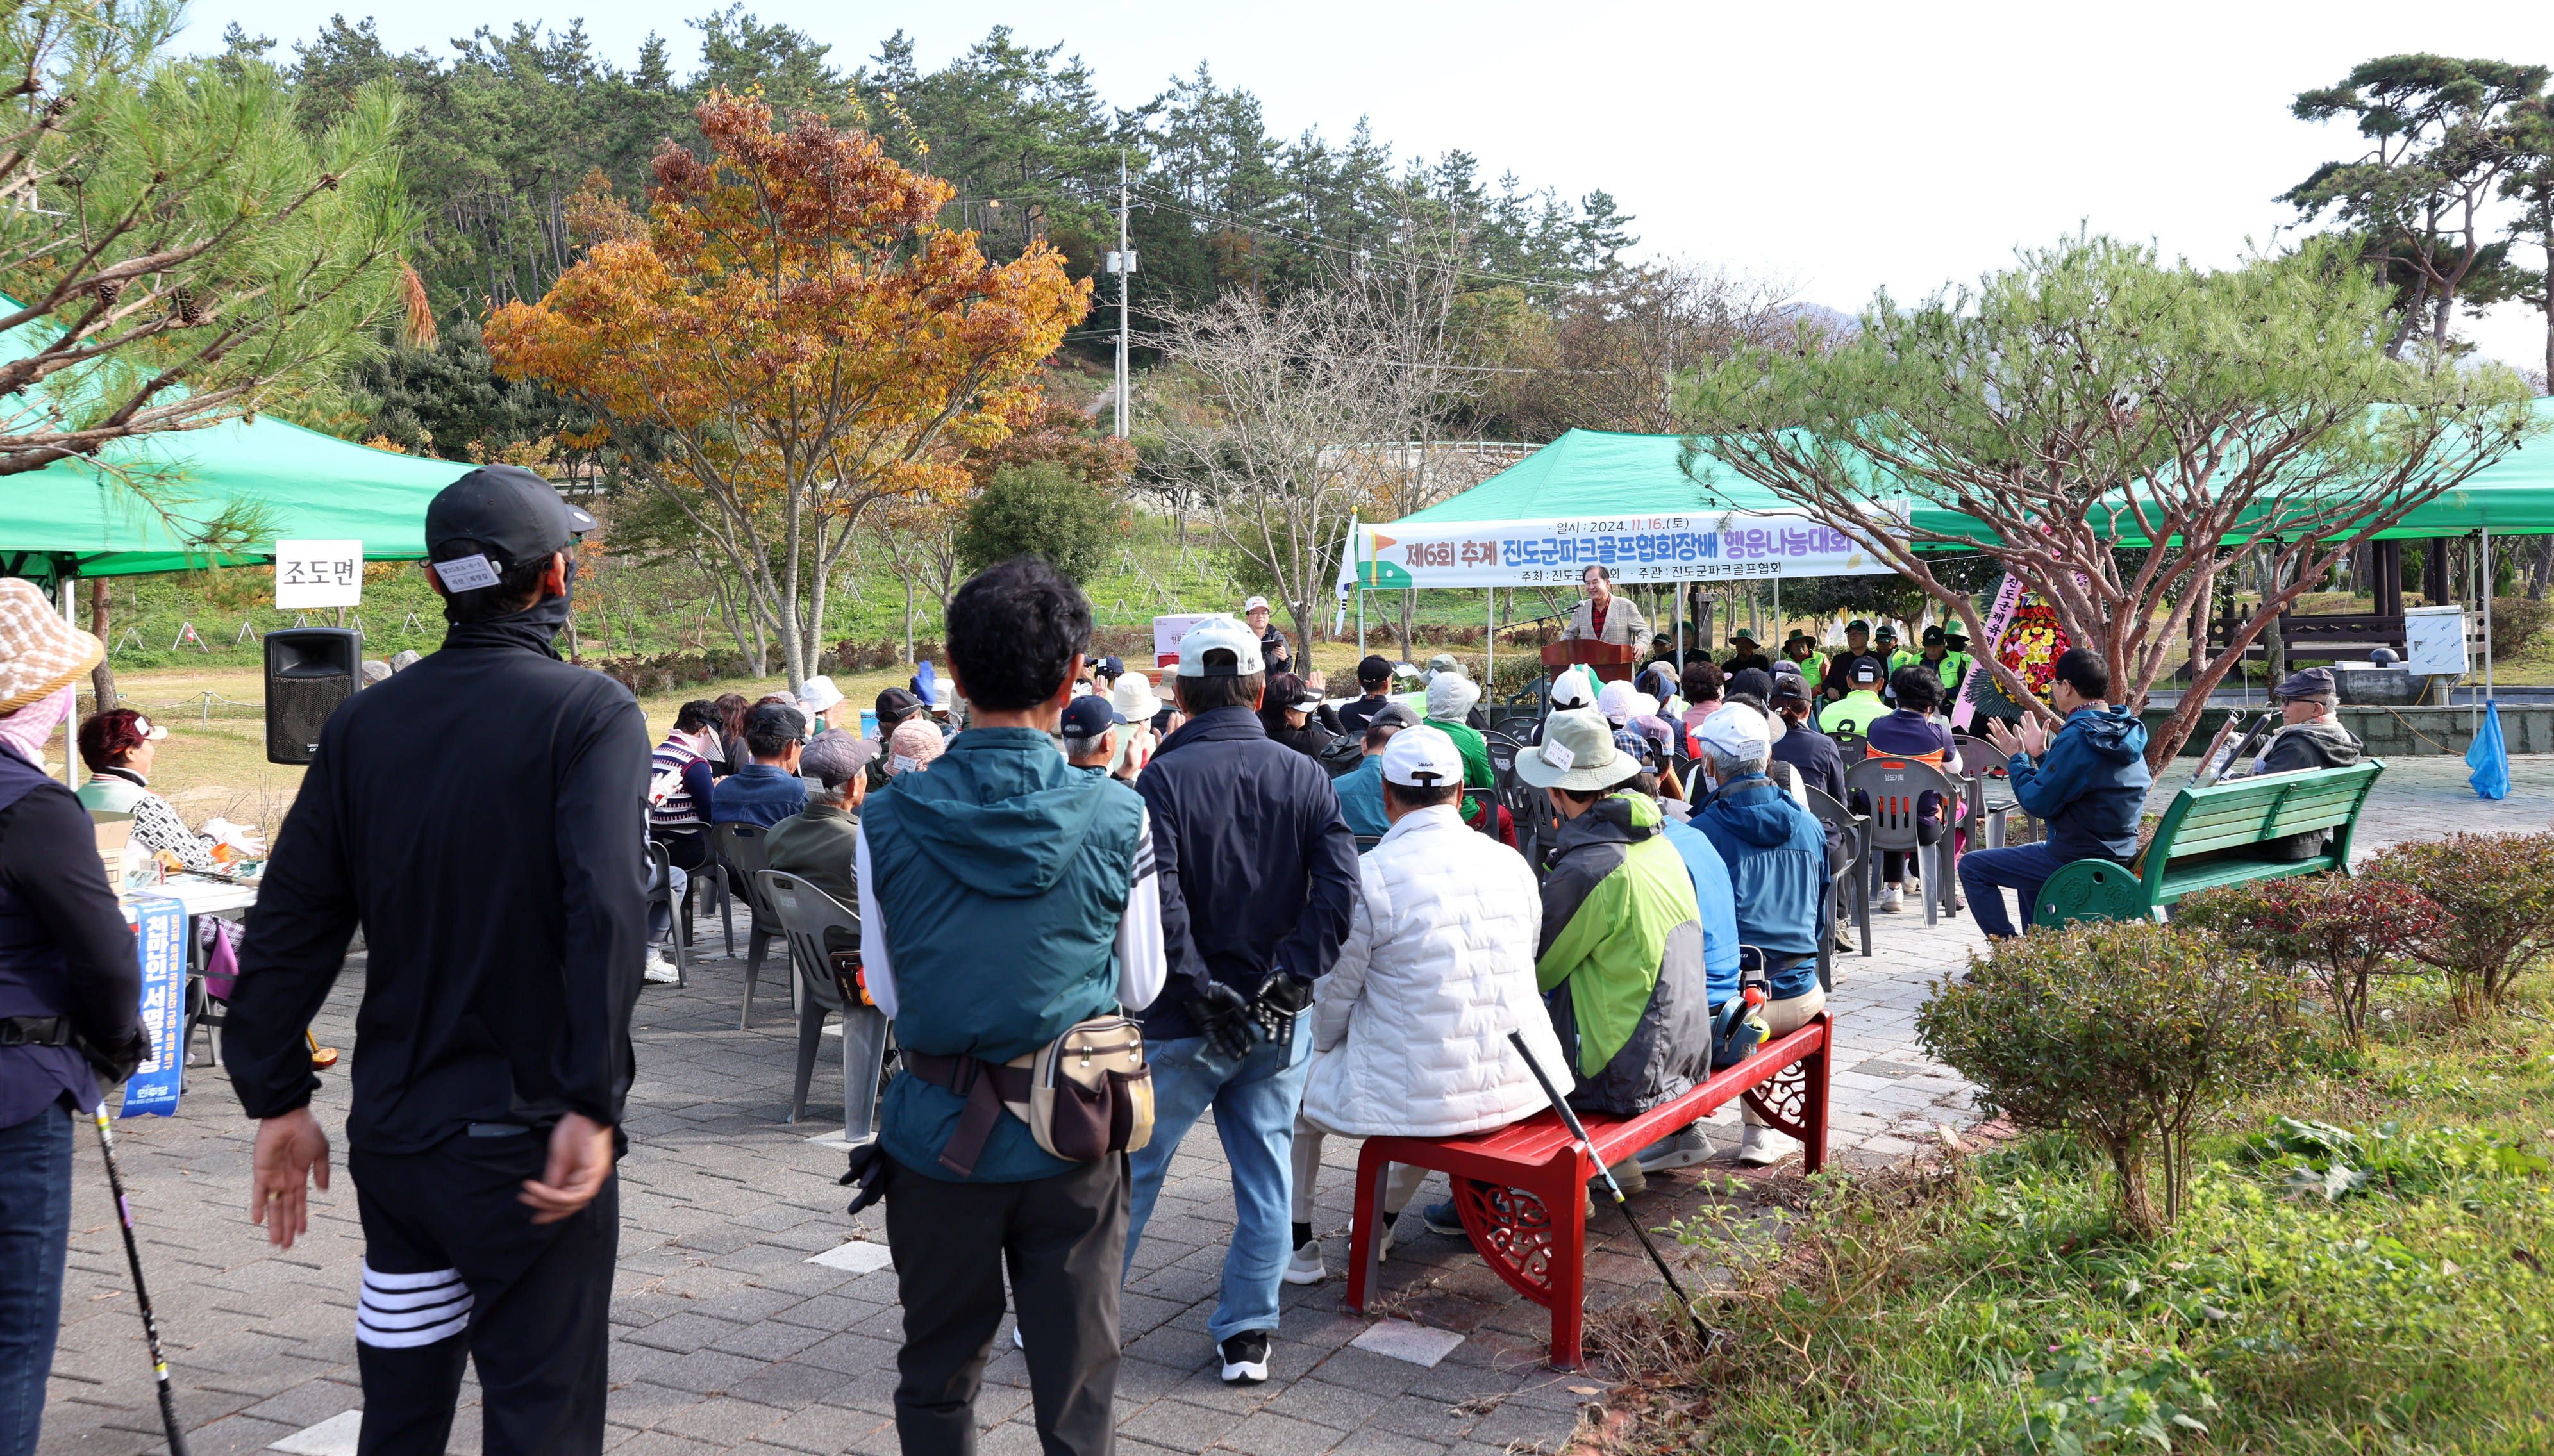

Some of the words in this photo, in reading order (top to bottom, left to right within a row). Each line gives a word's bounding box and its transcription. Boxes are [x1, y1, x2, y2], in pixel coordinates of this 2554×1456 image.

[1557, 522, 1580, 534] 일시
[1405, 541, 1455, 568] 제6회
[1460, 539, 1498, 568] 추계
[1503, 531, 1718, 567] 진도군파크골프협회장배
[1724, 524, 1853, 559] 행운나눔대회
[283, 559, 353, 586] 조도면
[1521, 570, 1542, 583] 주최
[1552, 567, 1620, 583] 진도군회
[1639, 567, 1662, 579] 주관
[1673, 561, 1782, 579] 진도군파크골프협회
[1884, 774, 1905, 782] 남도기획
[146, 914, 169, 983] 천만인
[137, 1085, 169, 1099] 민주당
